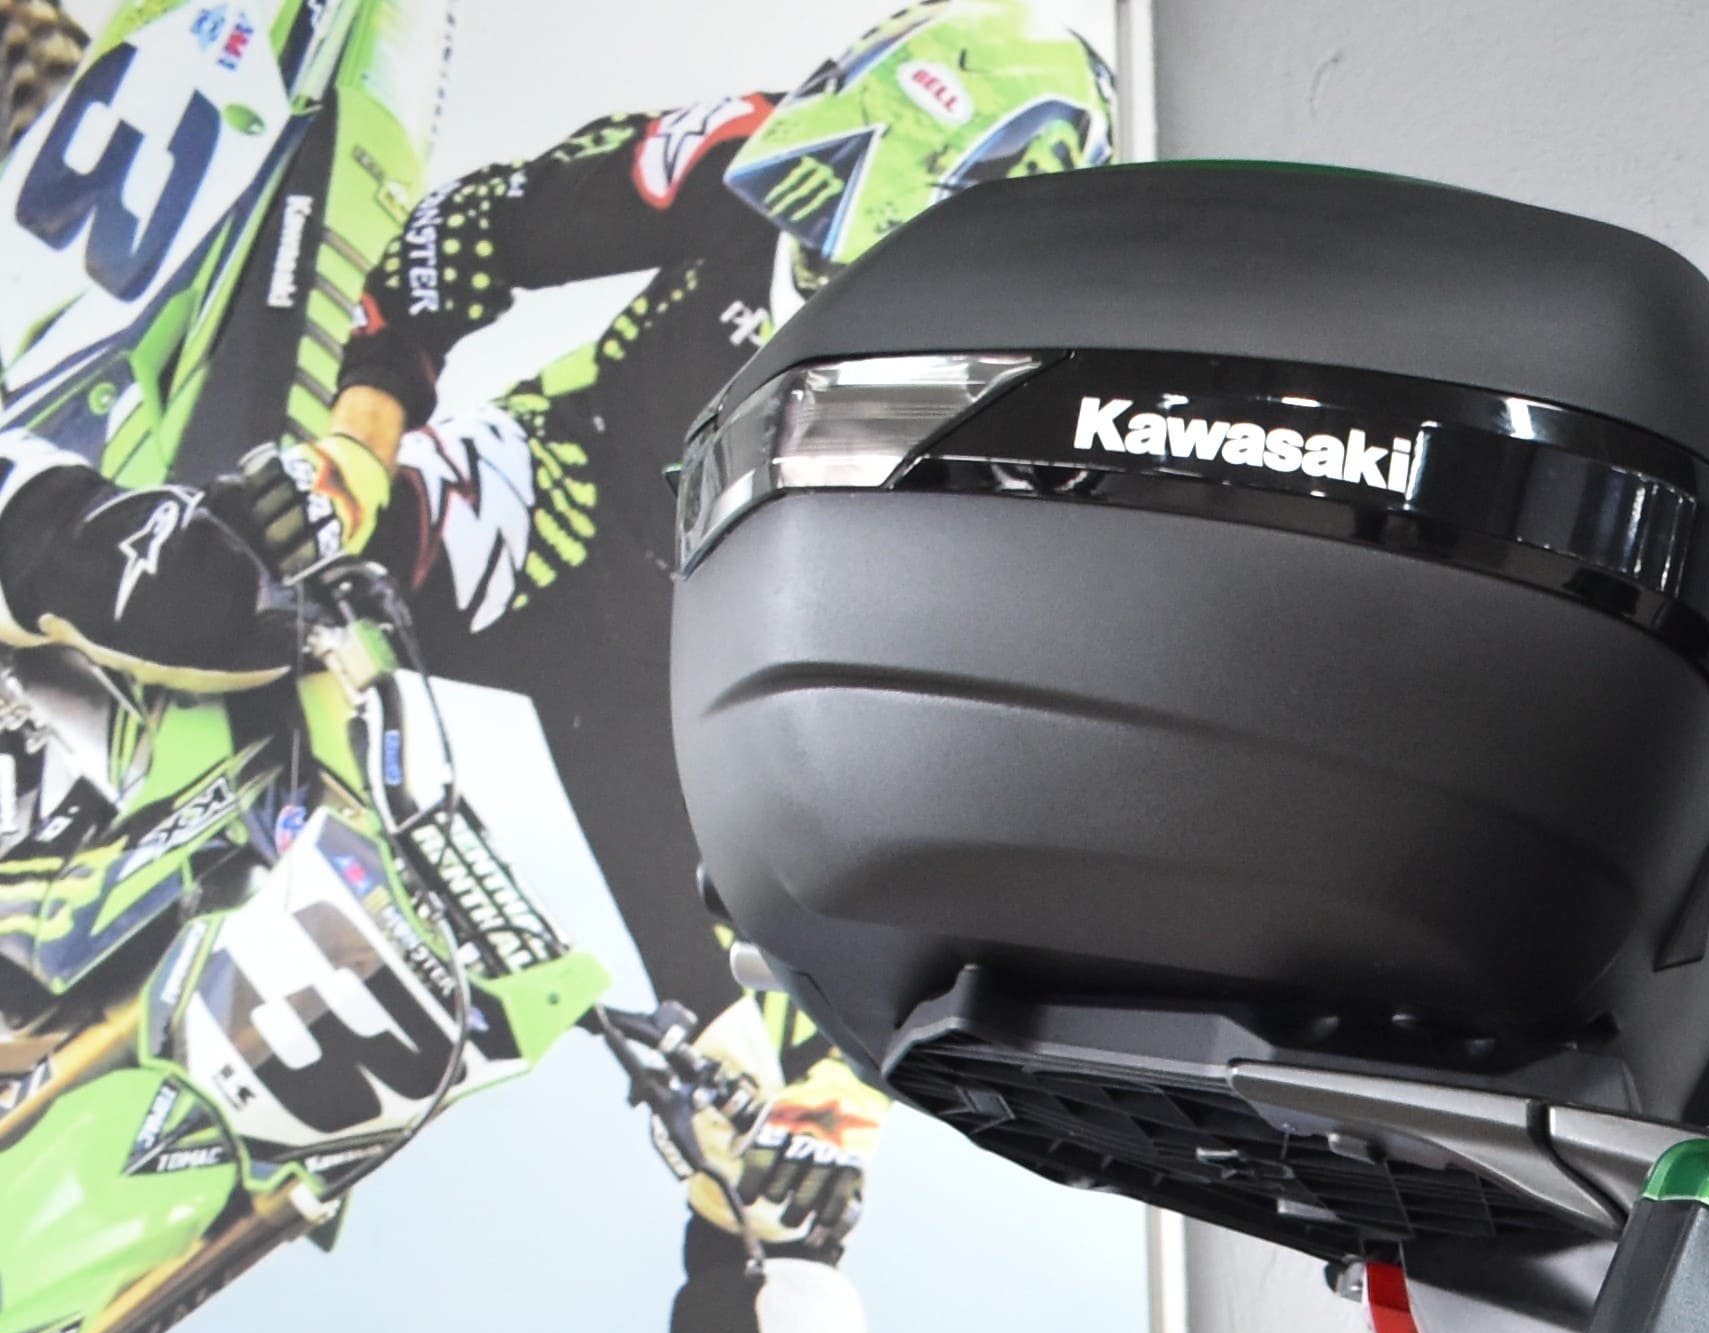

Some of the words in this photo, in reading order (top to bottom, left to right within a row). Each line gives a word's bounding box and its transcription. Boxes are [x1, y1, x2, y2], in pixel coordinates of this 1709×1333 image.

[911, 68, 958, 113] BELL
[15, 41, 222, 303] 3
[1073, 396, 1412, 494] Kawasaki
[202, 900, 468, 1134] 3
[156, 1146, 226, 1173] TOMAC
